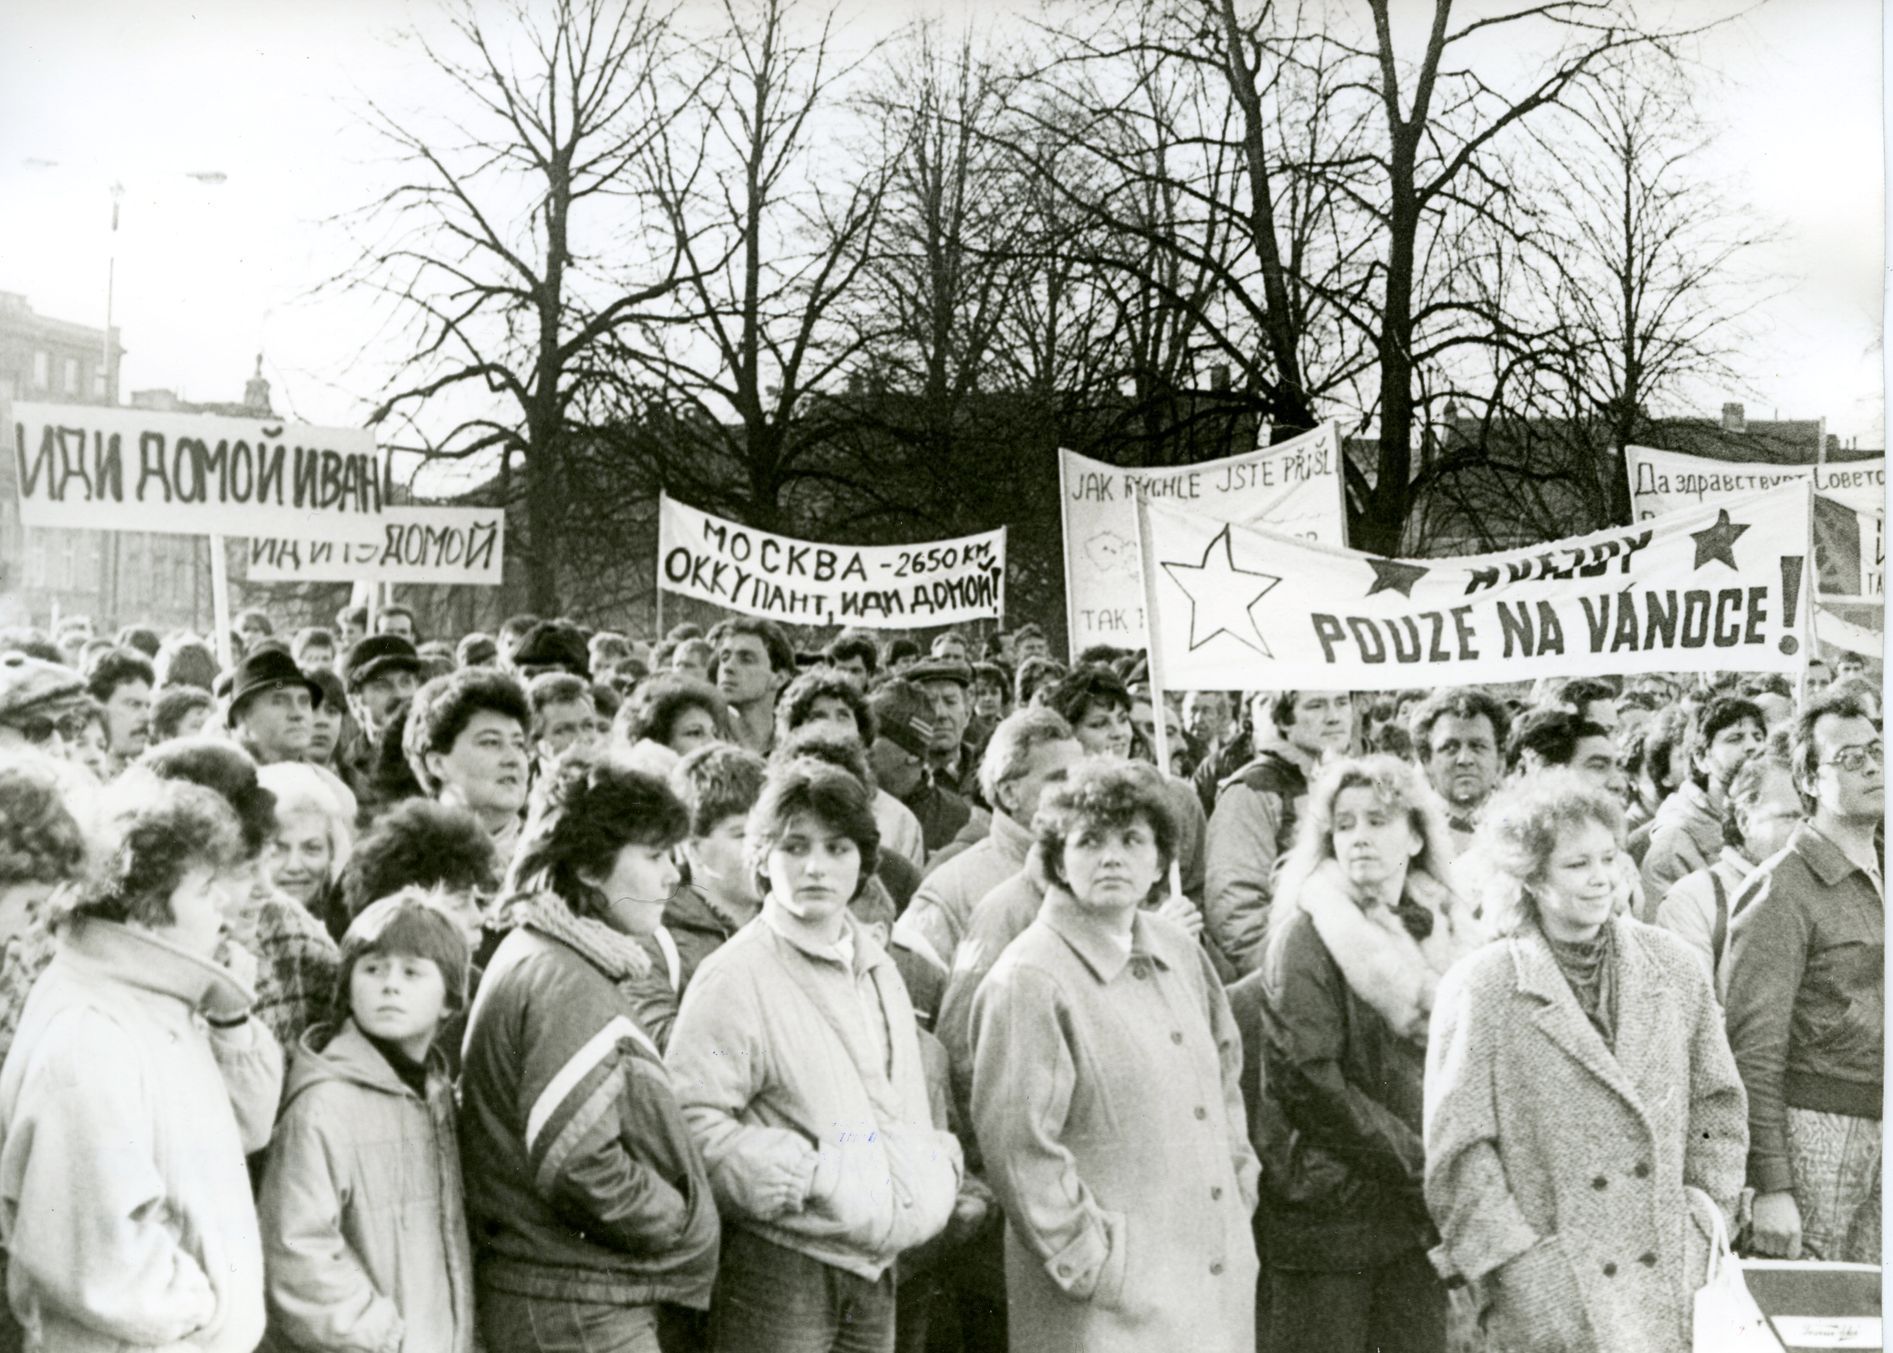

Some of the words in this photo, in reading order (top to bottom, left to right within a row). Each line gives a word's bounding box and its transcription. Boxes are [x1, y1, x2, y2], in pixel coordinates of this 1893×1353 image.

[15, 422, 123, 502] ИДИ
[136, 426, 285, 506] ДОМОЙ
[293, 446, 382, 513] ИВАН
[1072, 472, 1113, 502] JAK
[1123, 473, 1201, 500] RYCHLE
[1216, 461, 1274, 492] JSTE
[1634, 461, 1671, 497] Да
[379, 520, 496, 569] ДОМОЙ
[704, 518, 867, 582] МОСКВА
[664, 547, 834, 625] ОККУПАНТ,
[841, 588, 904, 618] ИДИ
[911, 555, 1002, 615] ДОМОЙ!
[1080, 607, 1128, 632] TAK
[1310, 604, 1480, 664] POUZE
[1497, 600, 1565, 659] NA
